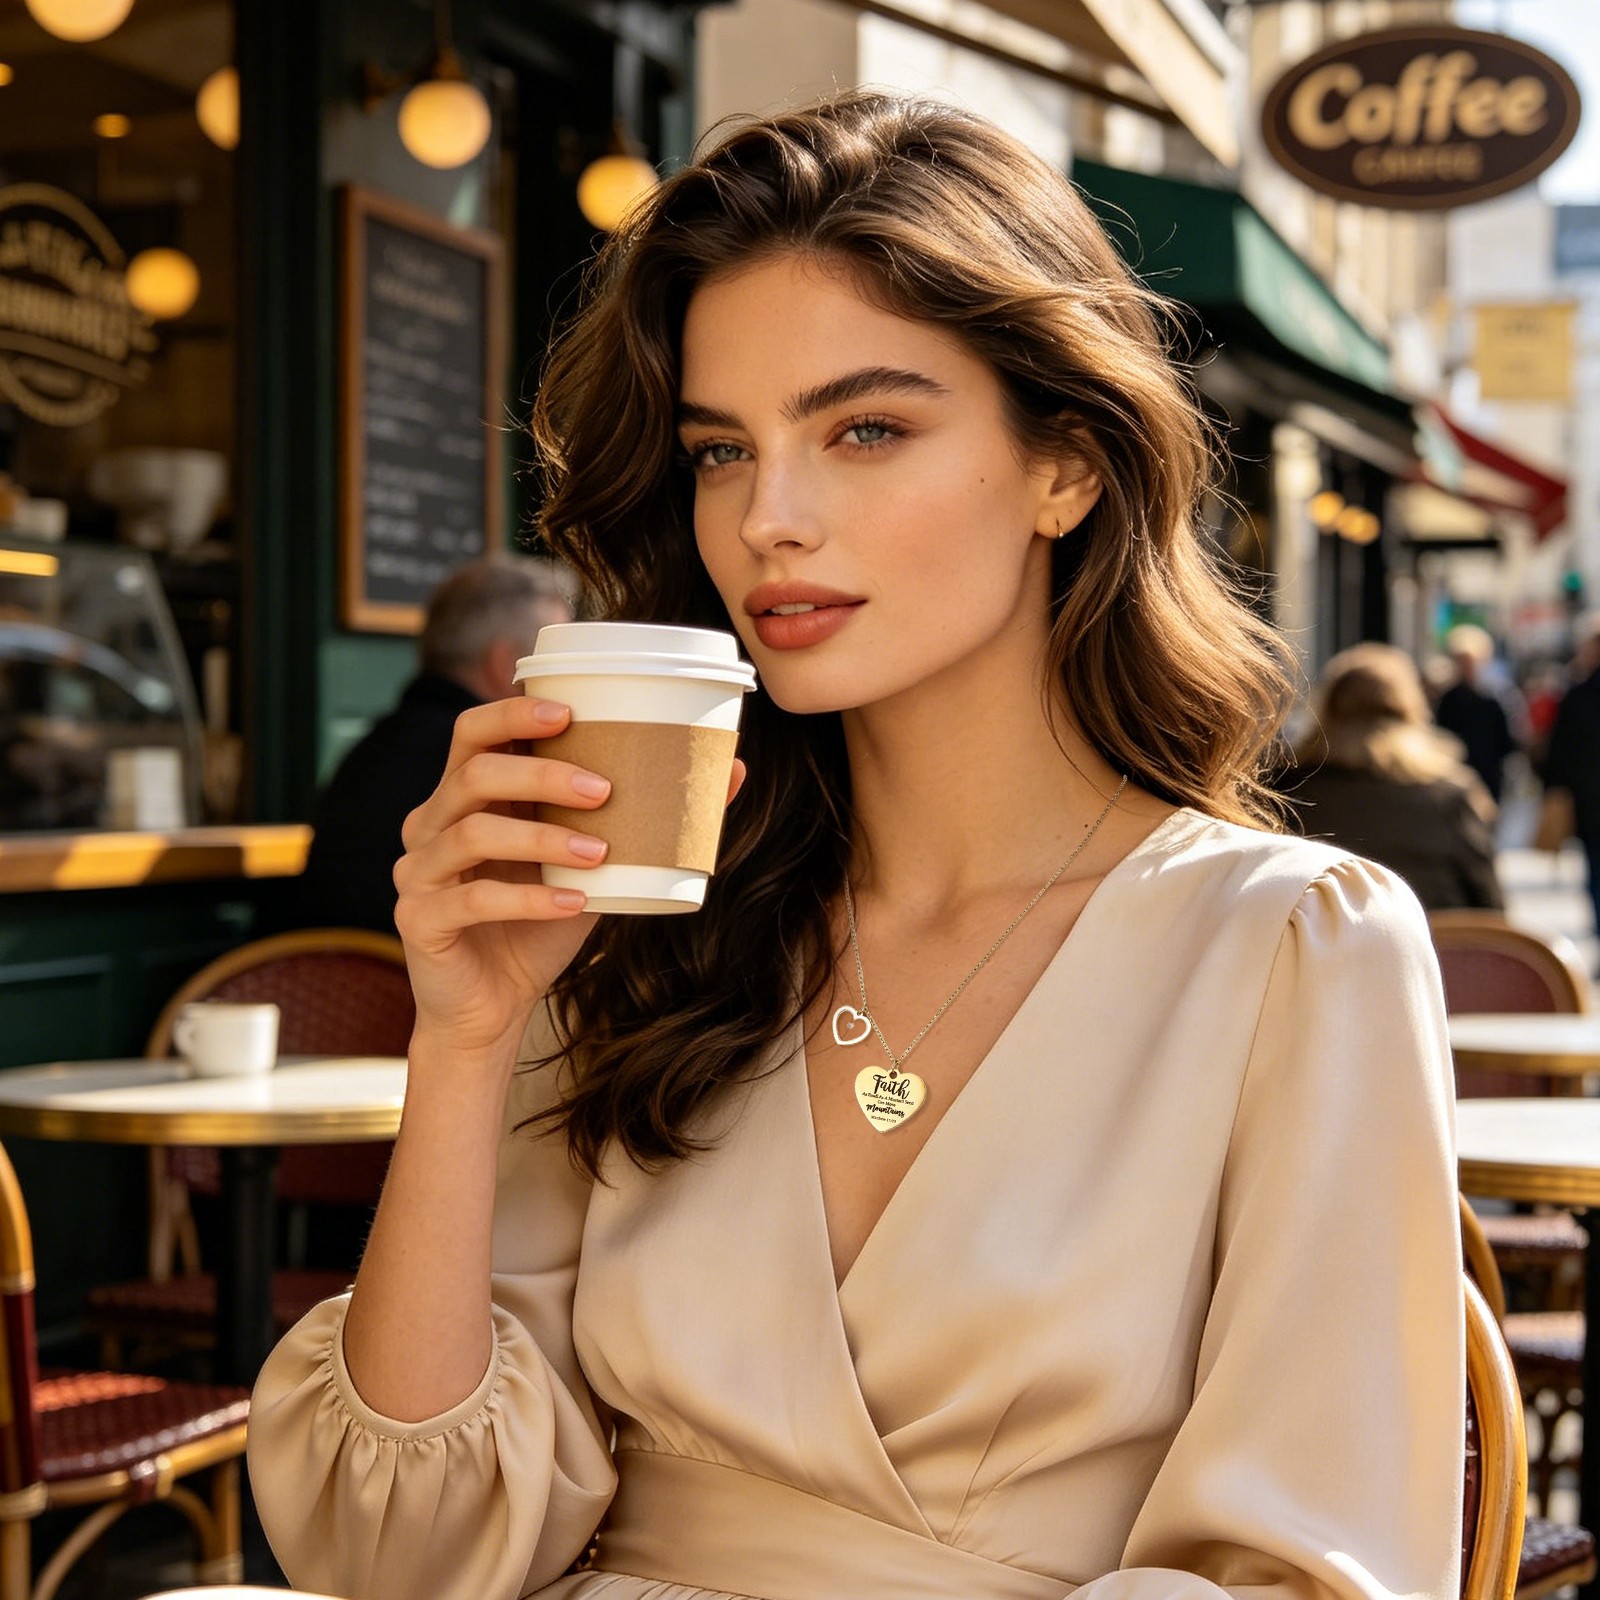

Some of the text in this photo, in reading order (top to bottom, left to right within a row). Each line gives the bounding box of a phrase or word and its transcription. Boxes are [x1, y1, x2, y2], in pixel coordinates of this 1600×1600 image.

[1287, 51, 1548, 150] Coffee
[873, 1074, 910, 1099] Faith
[866, 1104, 905, 1118] Mountains
